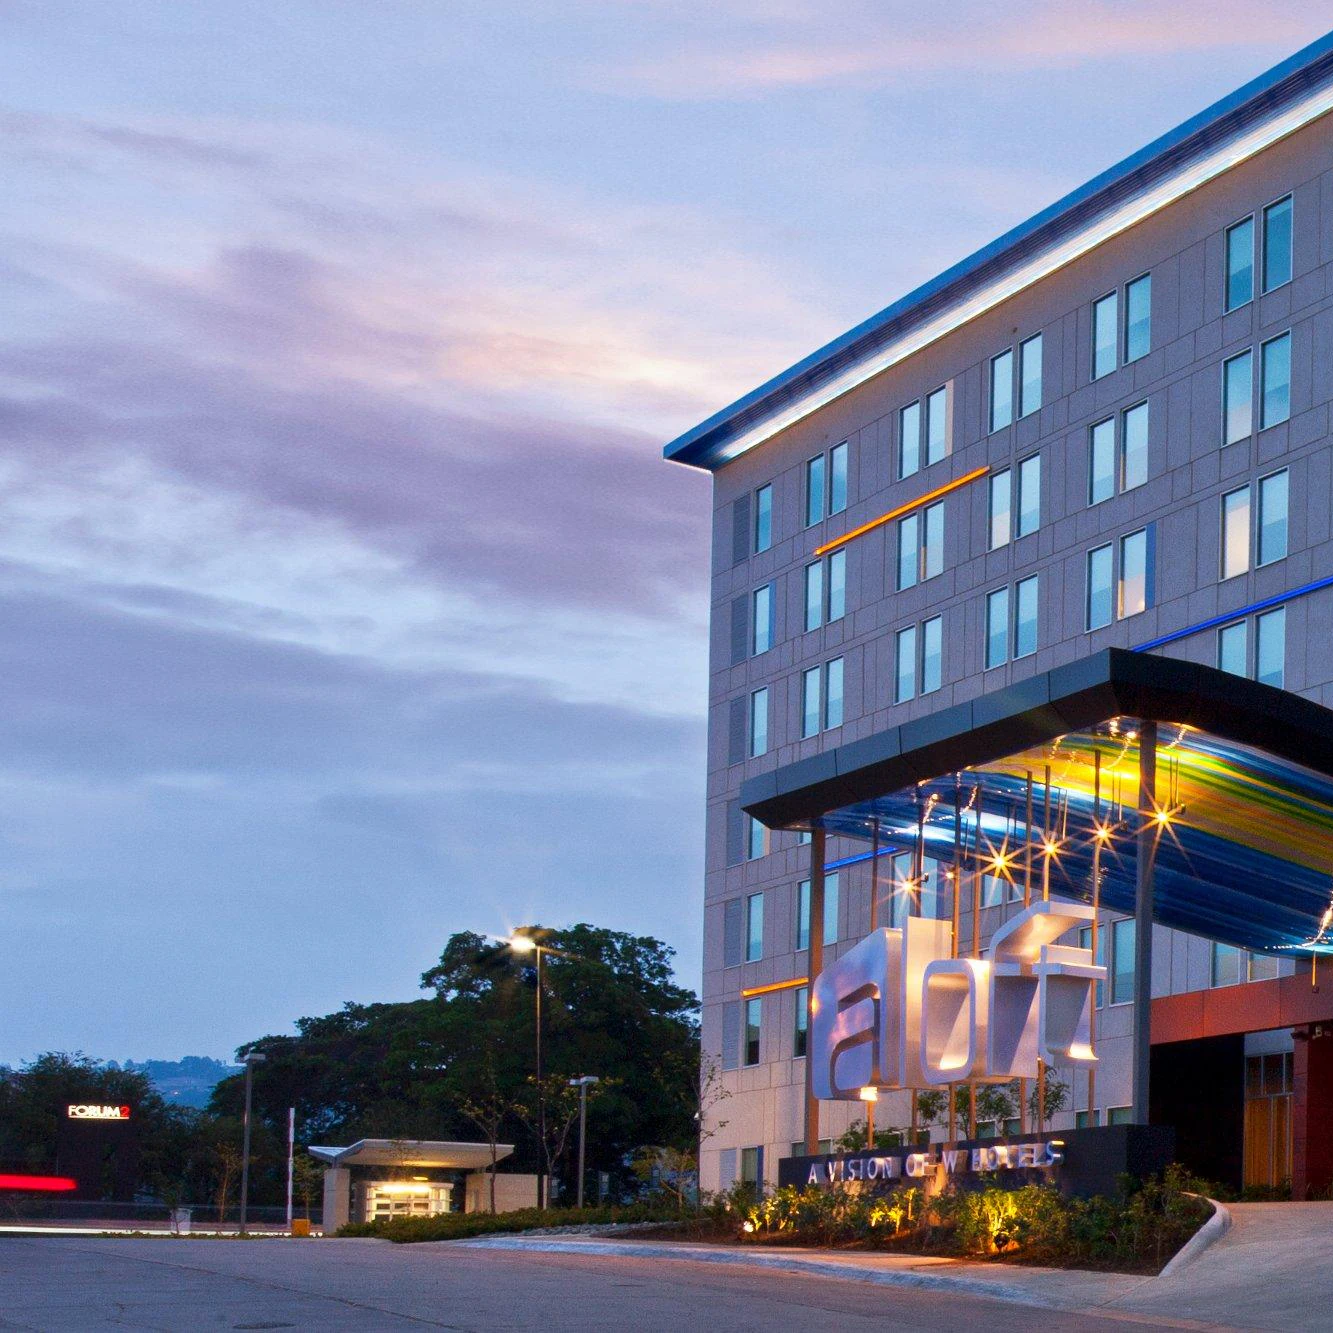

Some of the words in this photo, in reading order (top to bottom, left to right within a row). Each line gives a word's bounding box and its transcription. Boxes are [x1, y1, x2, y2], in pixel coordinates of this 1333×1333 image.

[812, 901, 1107, 1101] aloft
[807, 1162, 818, 1184] A
[828, 1156, 893, 1183] VISION
[942, 1149, 960, 1174] W
[972, 1141, 1064, 1172] HOTELS
